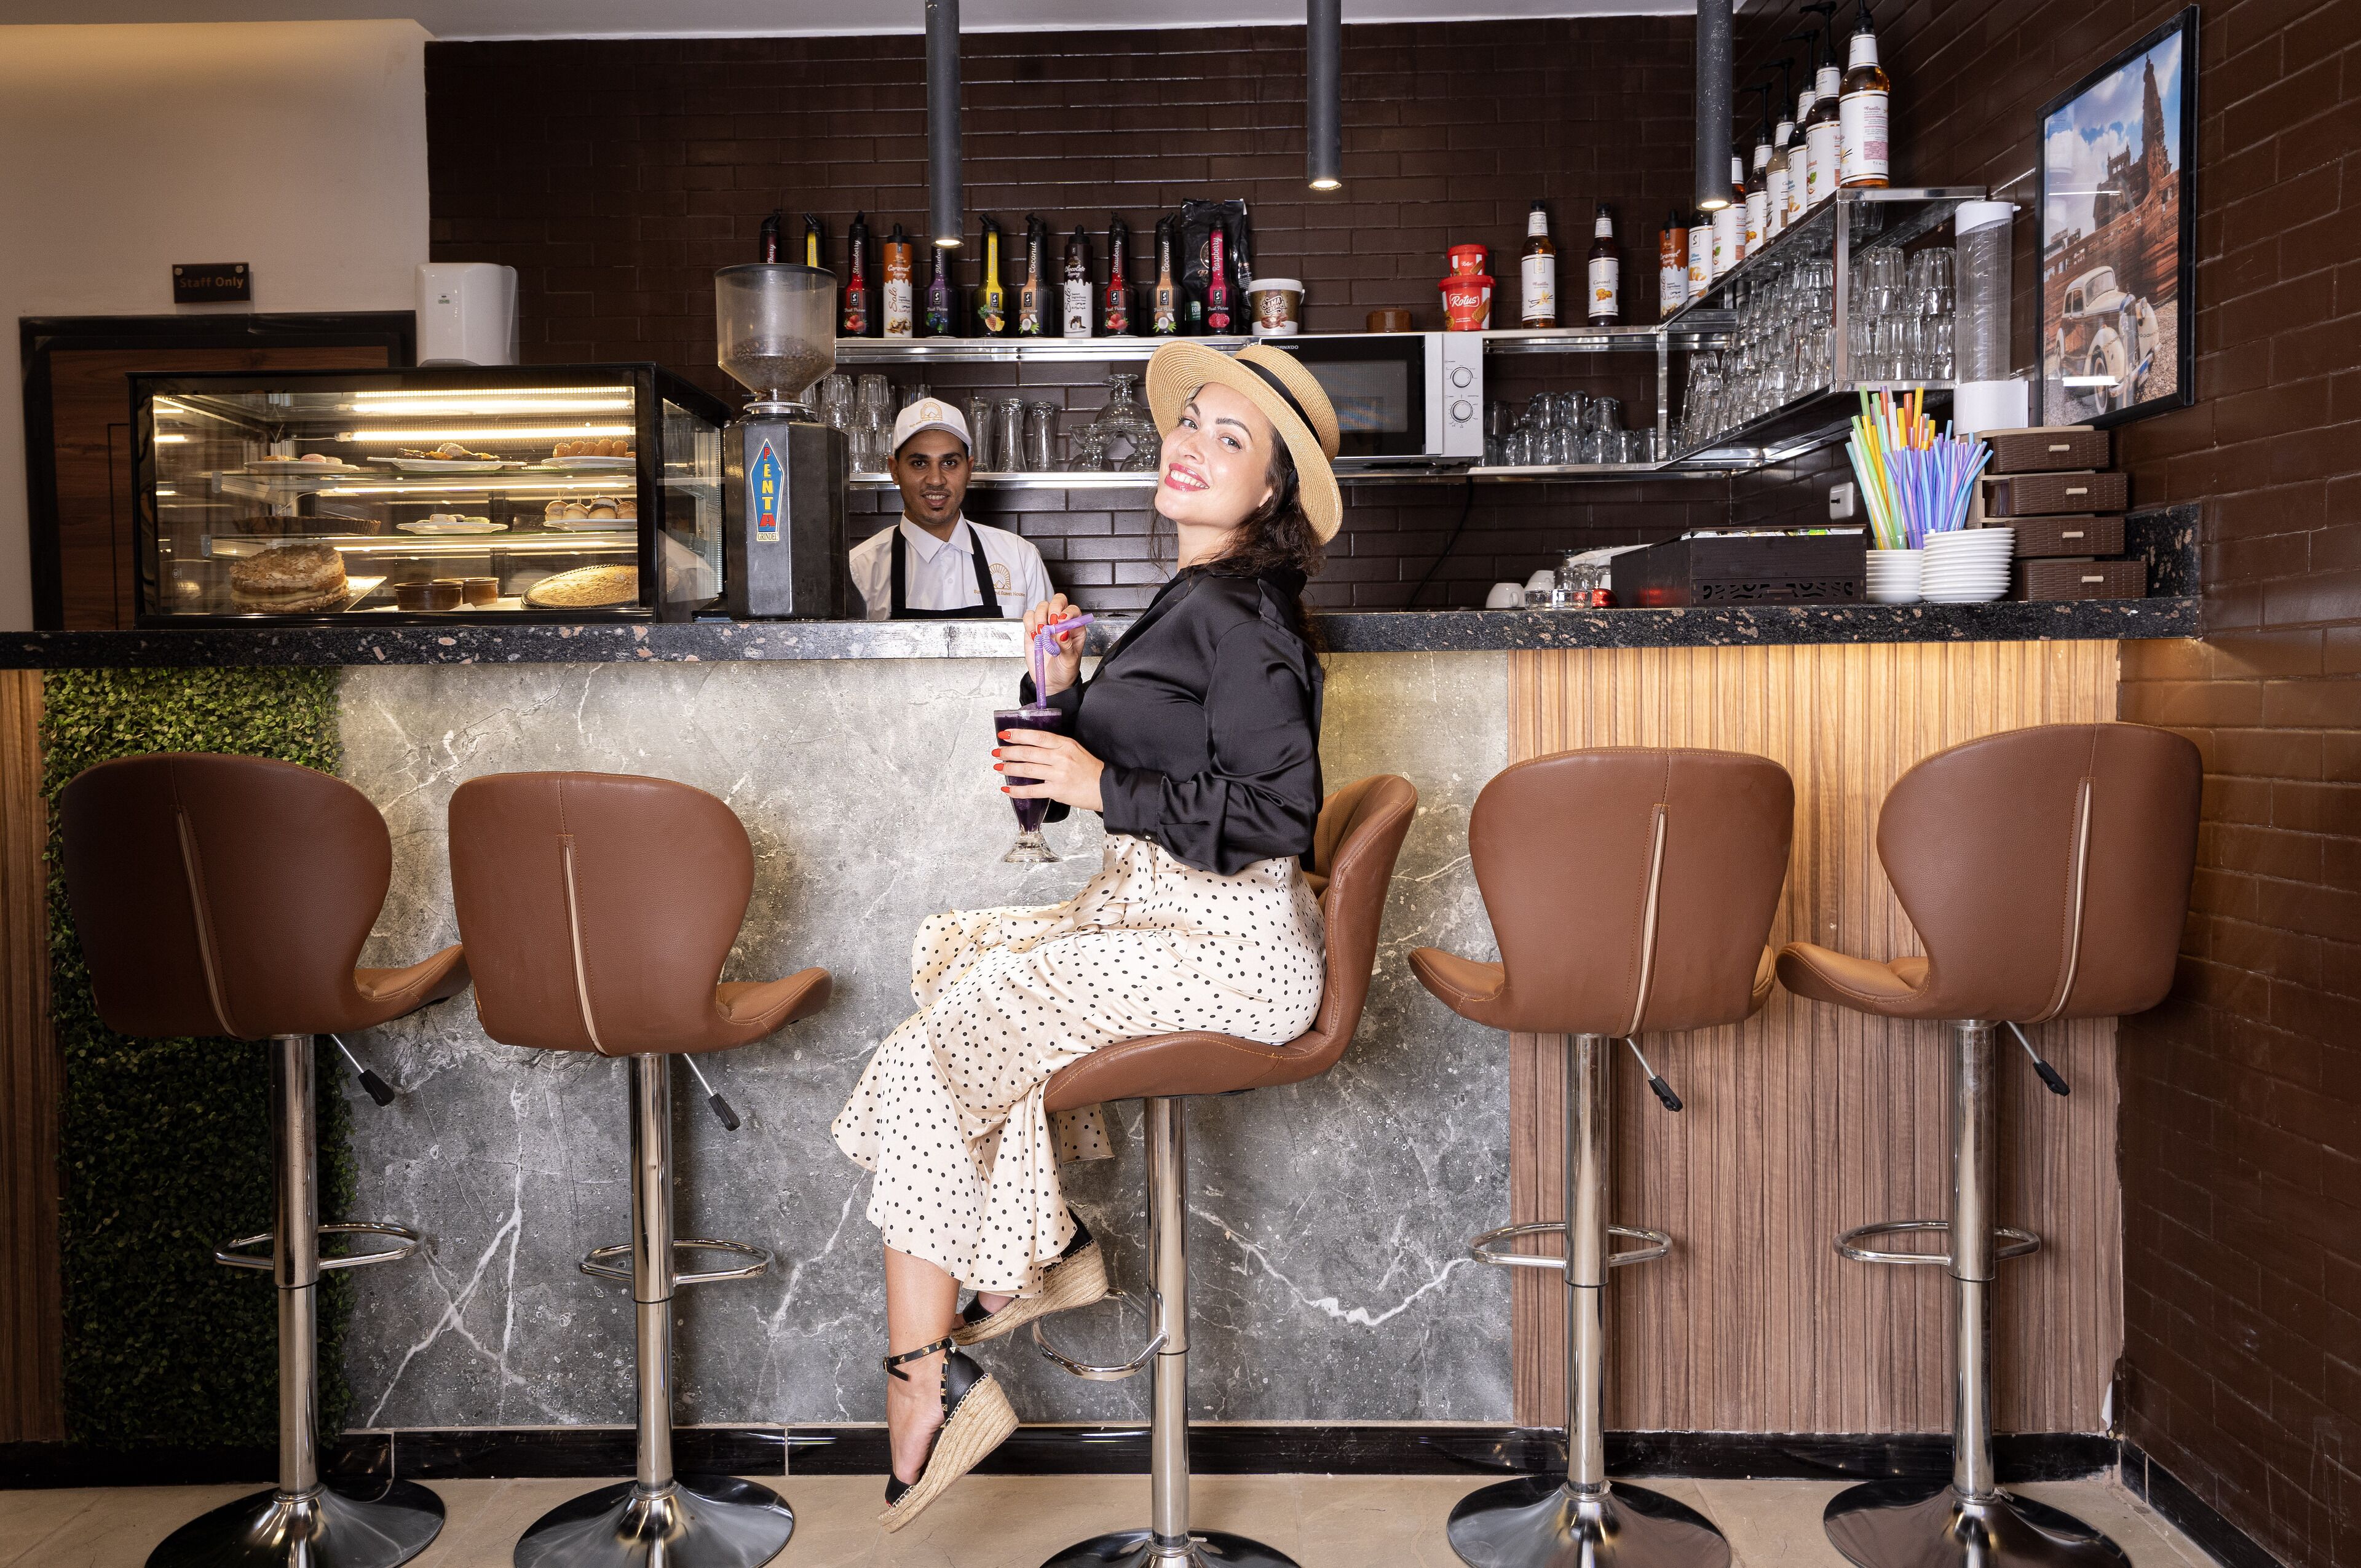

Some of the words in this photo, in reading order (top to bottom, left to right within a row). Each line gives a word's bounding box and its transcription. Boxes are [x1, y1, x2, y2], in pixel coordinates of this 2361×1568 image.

[852, 239, 861, 274] Strawberry
[1029, 240, 1037, 273] Coconut
[1064, 264, 1086, 272] Chocolate
[1112, 240, 1121, 273] Strawberry
[1161, 240, 1169, 272] Coconut
[1211, 237, 1222, 272] Raspberry
[179, 277, 212, 288] Staff
[215, 275, 244, 288] Only
[888, 287, 897, 312] Solo
[1451, 295, 1477, 307] Rotus
[759, 447, 777, 527] PENTA
